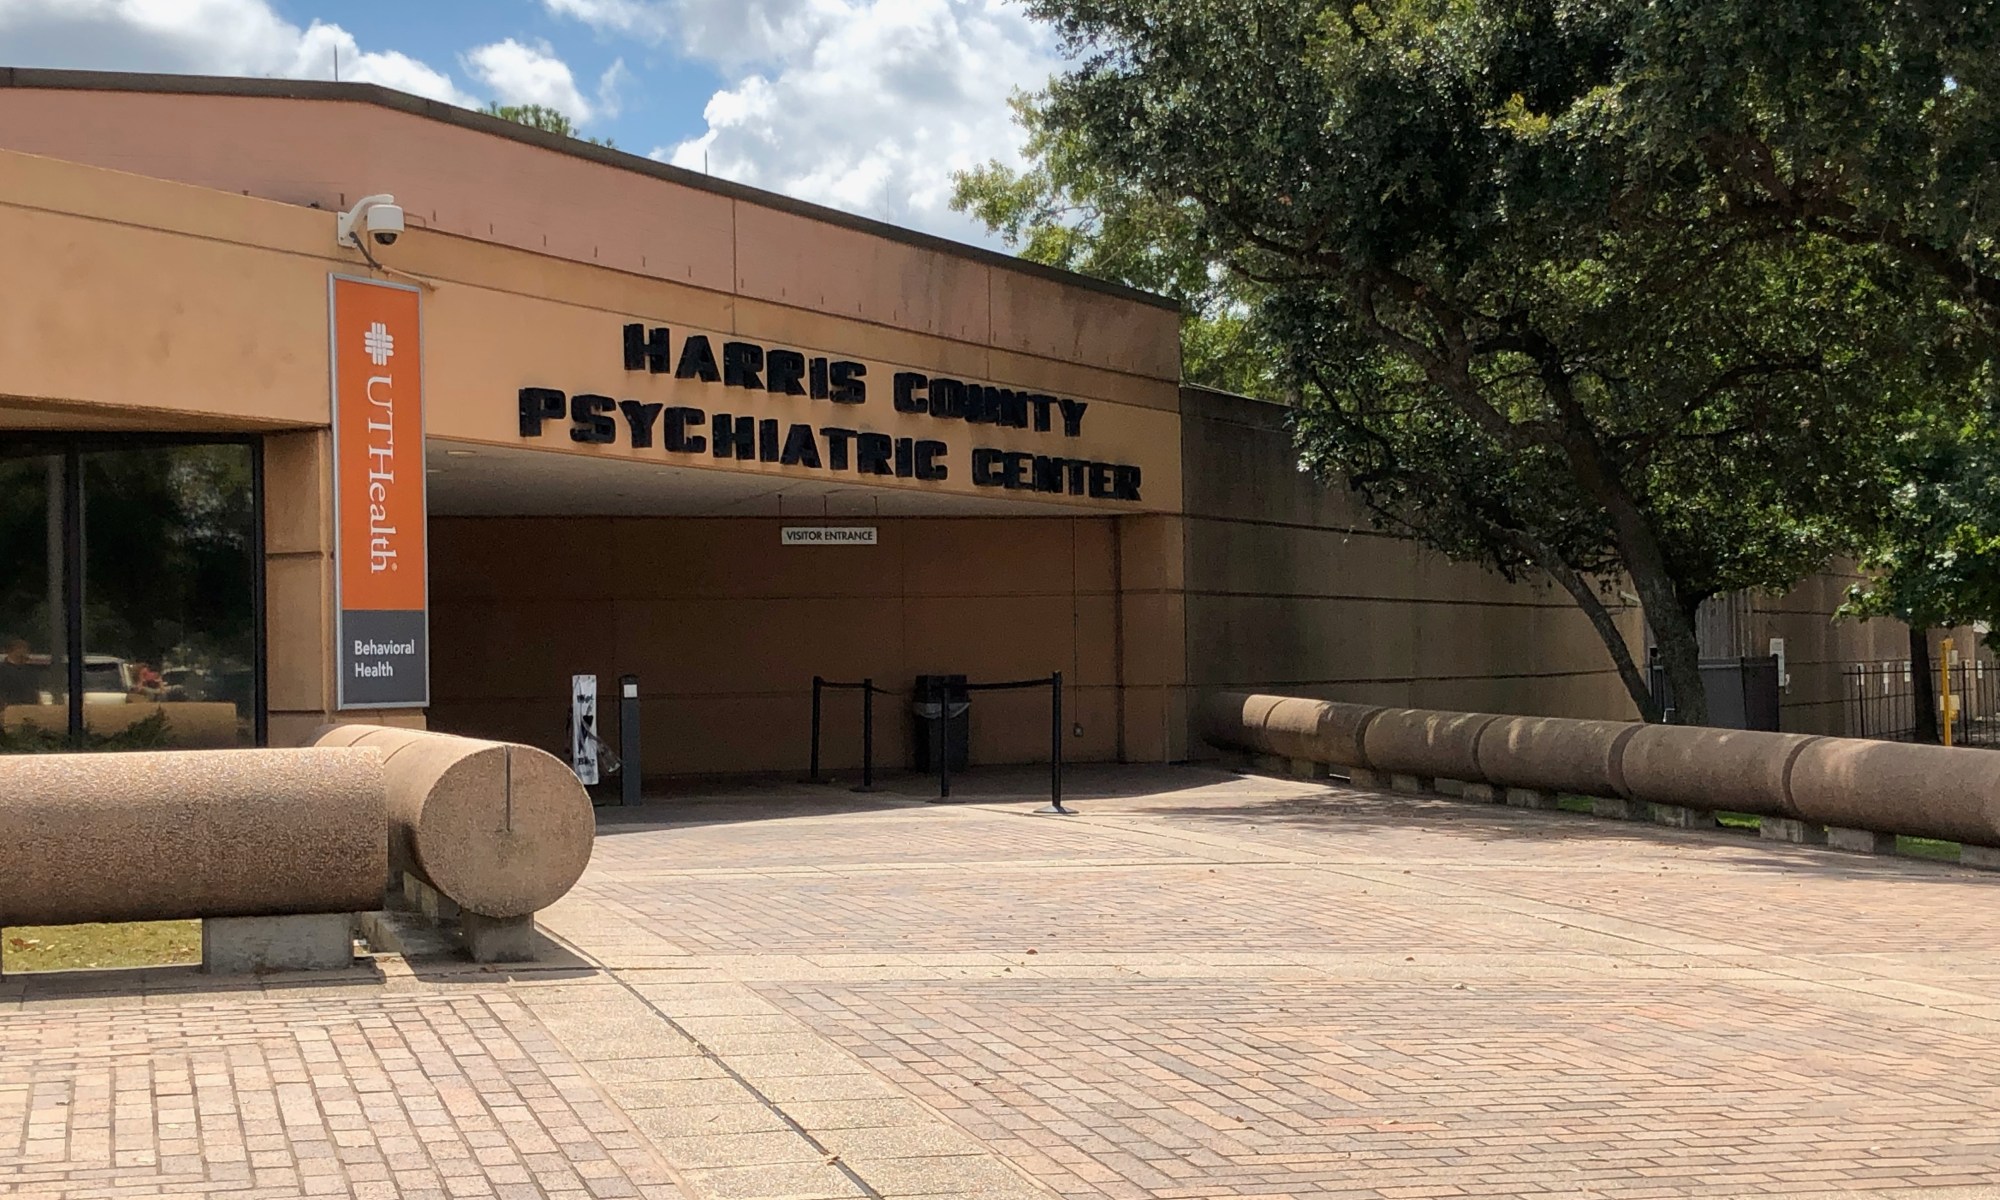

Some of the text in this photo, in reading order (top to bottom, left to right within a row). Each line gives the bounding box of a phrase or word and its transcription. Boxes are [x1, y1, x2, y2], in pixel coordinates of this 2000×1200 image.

[623, 323, 1089, 437] HARRIS COUNTY
[367, 374, 398, 574] UTHealth
[519, 387, 1142, 502] PSYCHIATRIC CENTER
[786, 531, 873, 541] VISITOR ENTRANCE
[354, 638, 415, 655] Behavioral
[355, 661, 394, 678] Health
